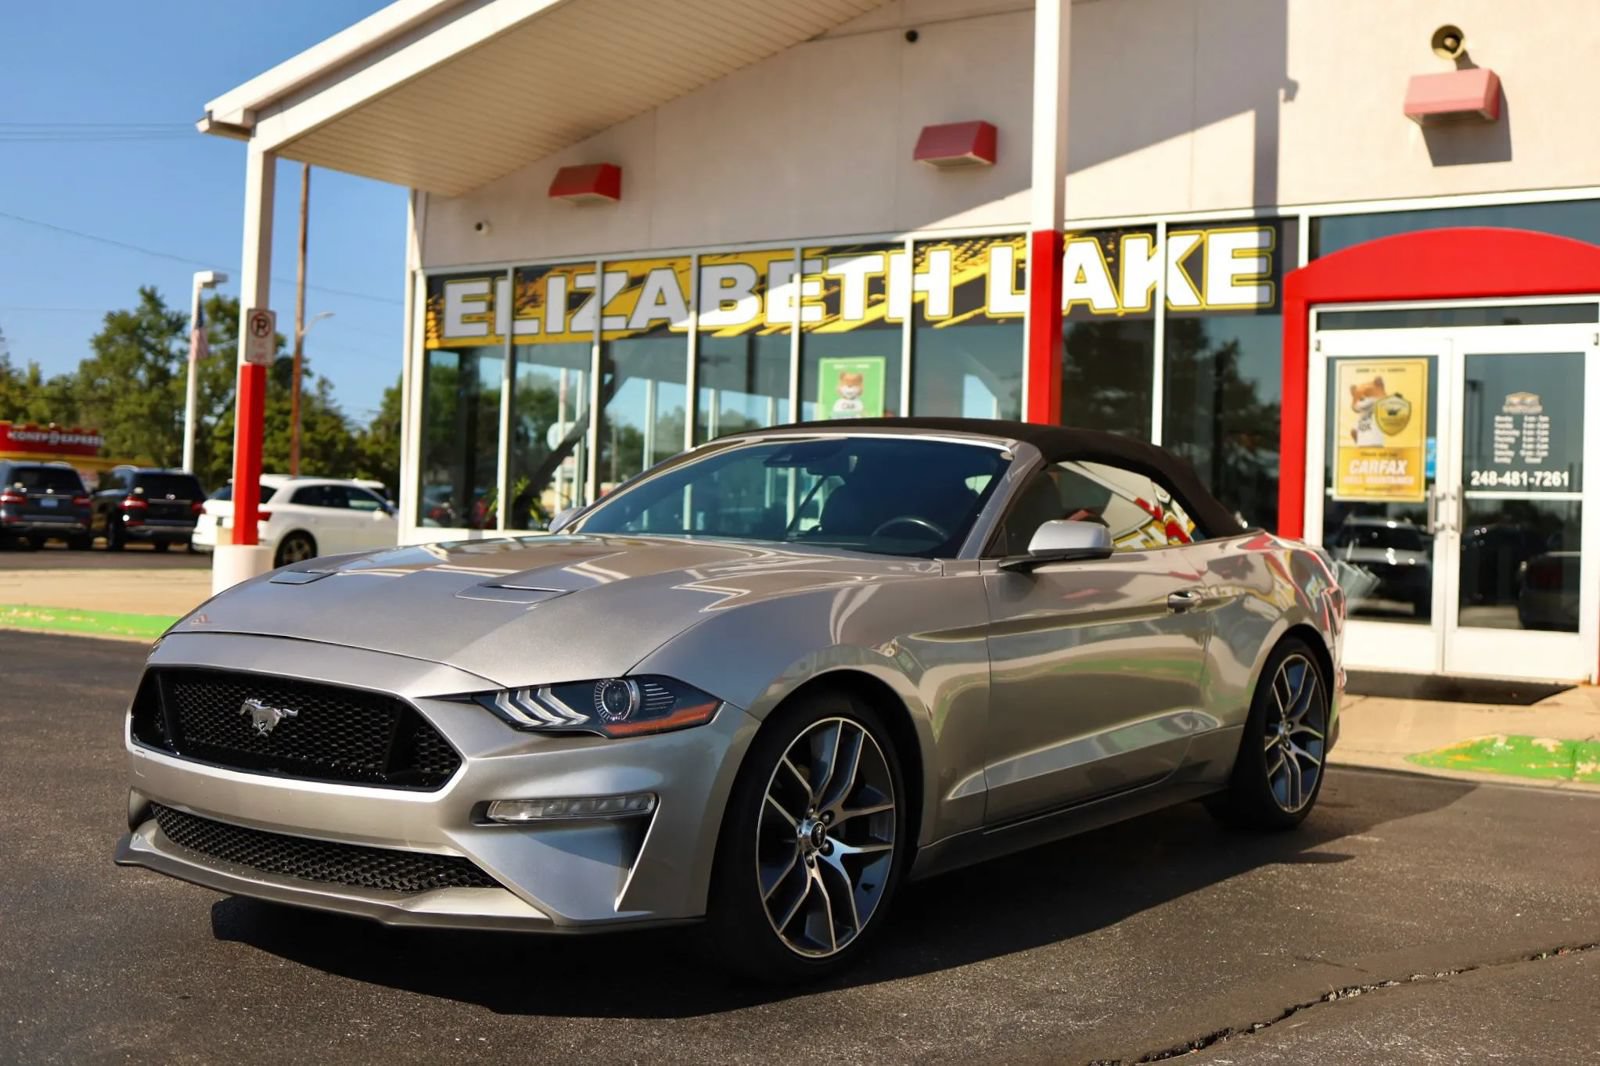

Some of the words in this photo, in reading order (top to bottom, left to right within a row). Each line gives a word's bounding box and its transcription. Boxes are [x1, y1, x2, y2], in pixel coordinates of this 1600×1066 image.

[442, 246, 955, 339] ELIZABETH
[985, 225, 1276, 319] LAKE
[1349, 458, 1409, 476] CARFAX
[1470, 470, 1570, 487] 248-481-7261
